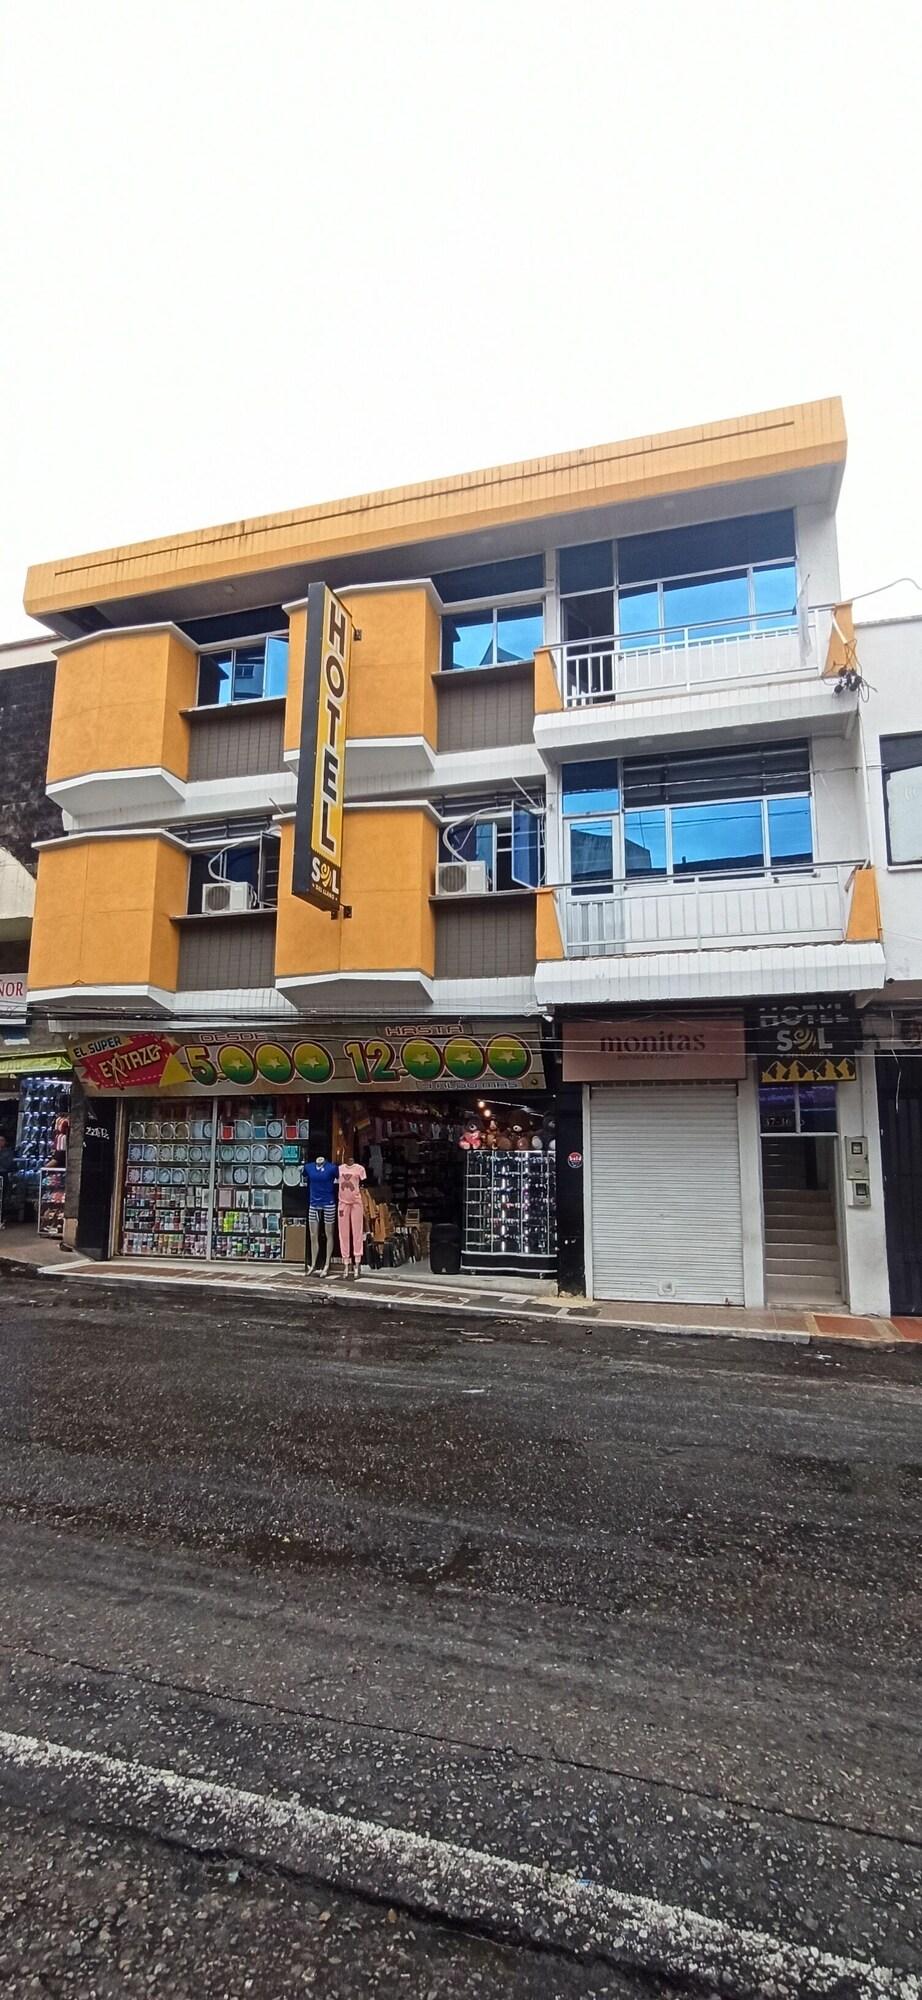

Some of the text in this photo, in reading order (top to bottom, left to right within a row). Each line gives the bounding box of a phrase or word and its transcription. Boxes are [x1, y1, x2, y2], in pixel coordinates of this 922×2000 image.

[320, 600, 346, 854] HOTEL
[311, 855, 340, 895] SOL
[199, 1032, 265, 1043] DESDE
[385, 1024, 464, 1036] HASTA
[599, 1030, 706, 1052] monitas
[776, 1028, 833, 1051] SOL
[73, 1036, 122, 1058] EL SUPER
[184, 1033, 533, 1087] 5.000 12.000
